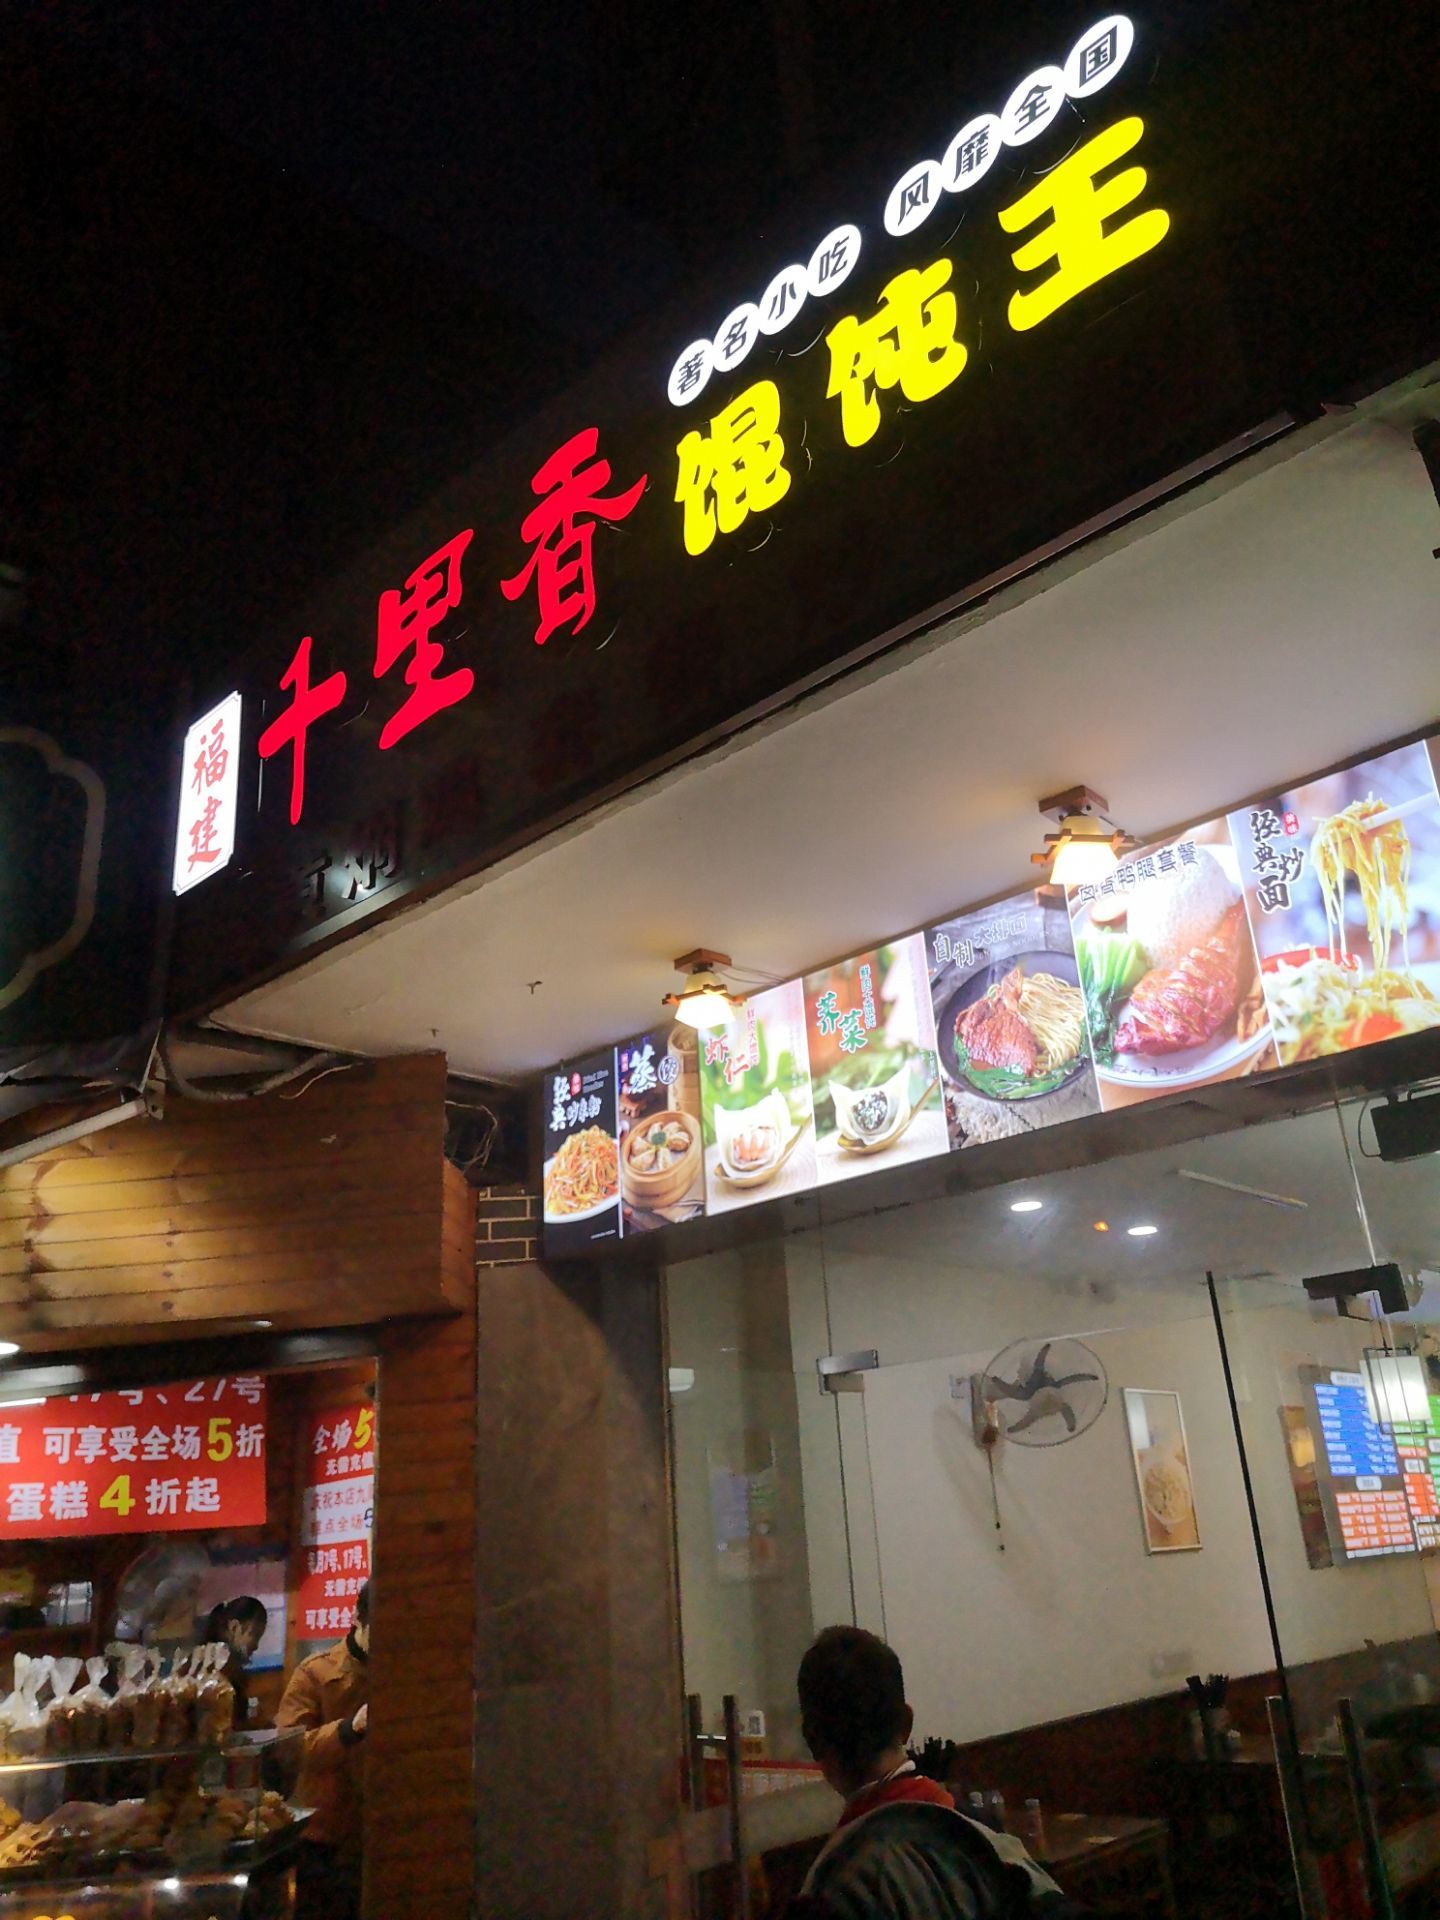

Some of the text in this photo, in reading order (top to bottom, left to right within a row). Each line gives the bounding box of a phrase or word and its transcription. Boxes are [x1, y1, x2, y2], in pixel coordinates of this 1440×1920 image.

[677, 25, 1118, 394] 著名小吃 风靡全国
[259, 117, 1170, 825] 千里香 馄饨王
[187, 719, 228, 873] 福建
[43, 1418, 265, 1464] 可享受全场5折
[7, 1475, 220, 1522] 蛋糕4折起
[305, 1604, 357, 1630] 可享受全
